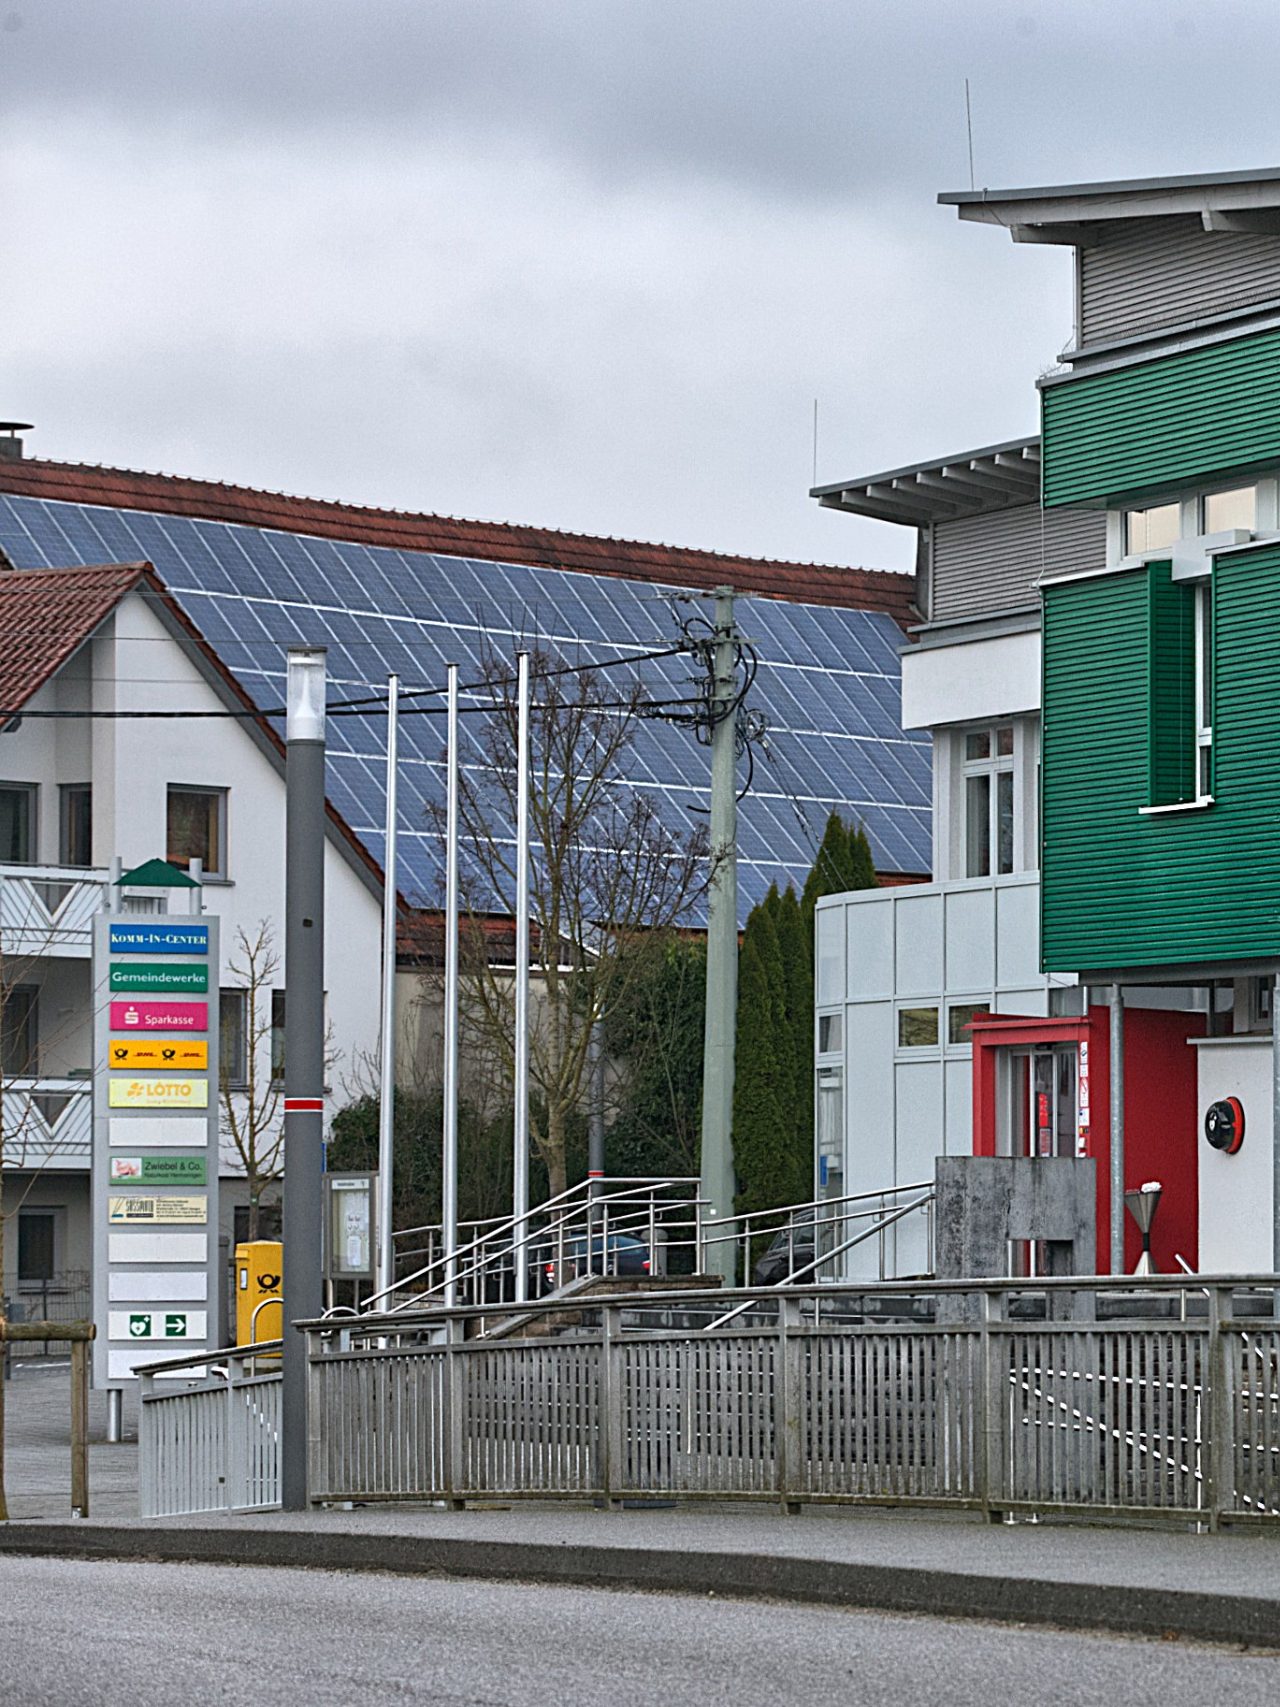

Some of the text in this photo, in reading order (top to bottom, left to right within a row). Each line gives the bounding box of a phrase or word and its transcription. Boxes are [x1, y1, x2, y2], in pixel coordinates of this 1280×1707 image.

[111, 971, 206, 983] Gemeindewerke
[144, 1014, 194, 1026] Sparkasse
[144, 1161, 178, 1170] Zwiebel
[180, 1161, 186, 1170] &
